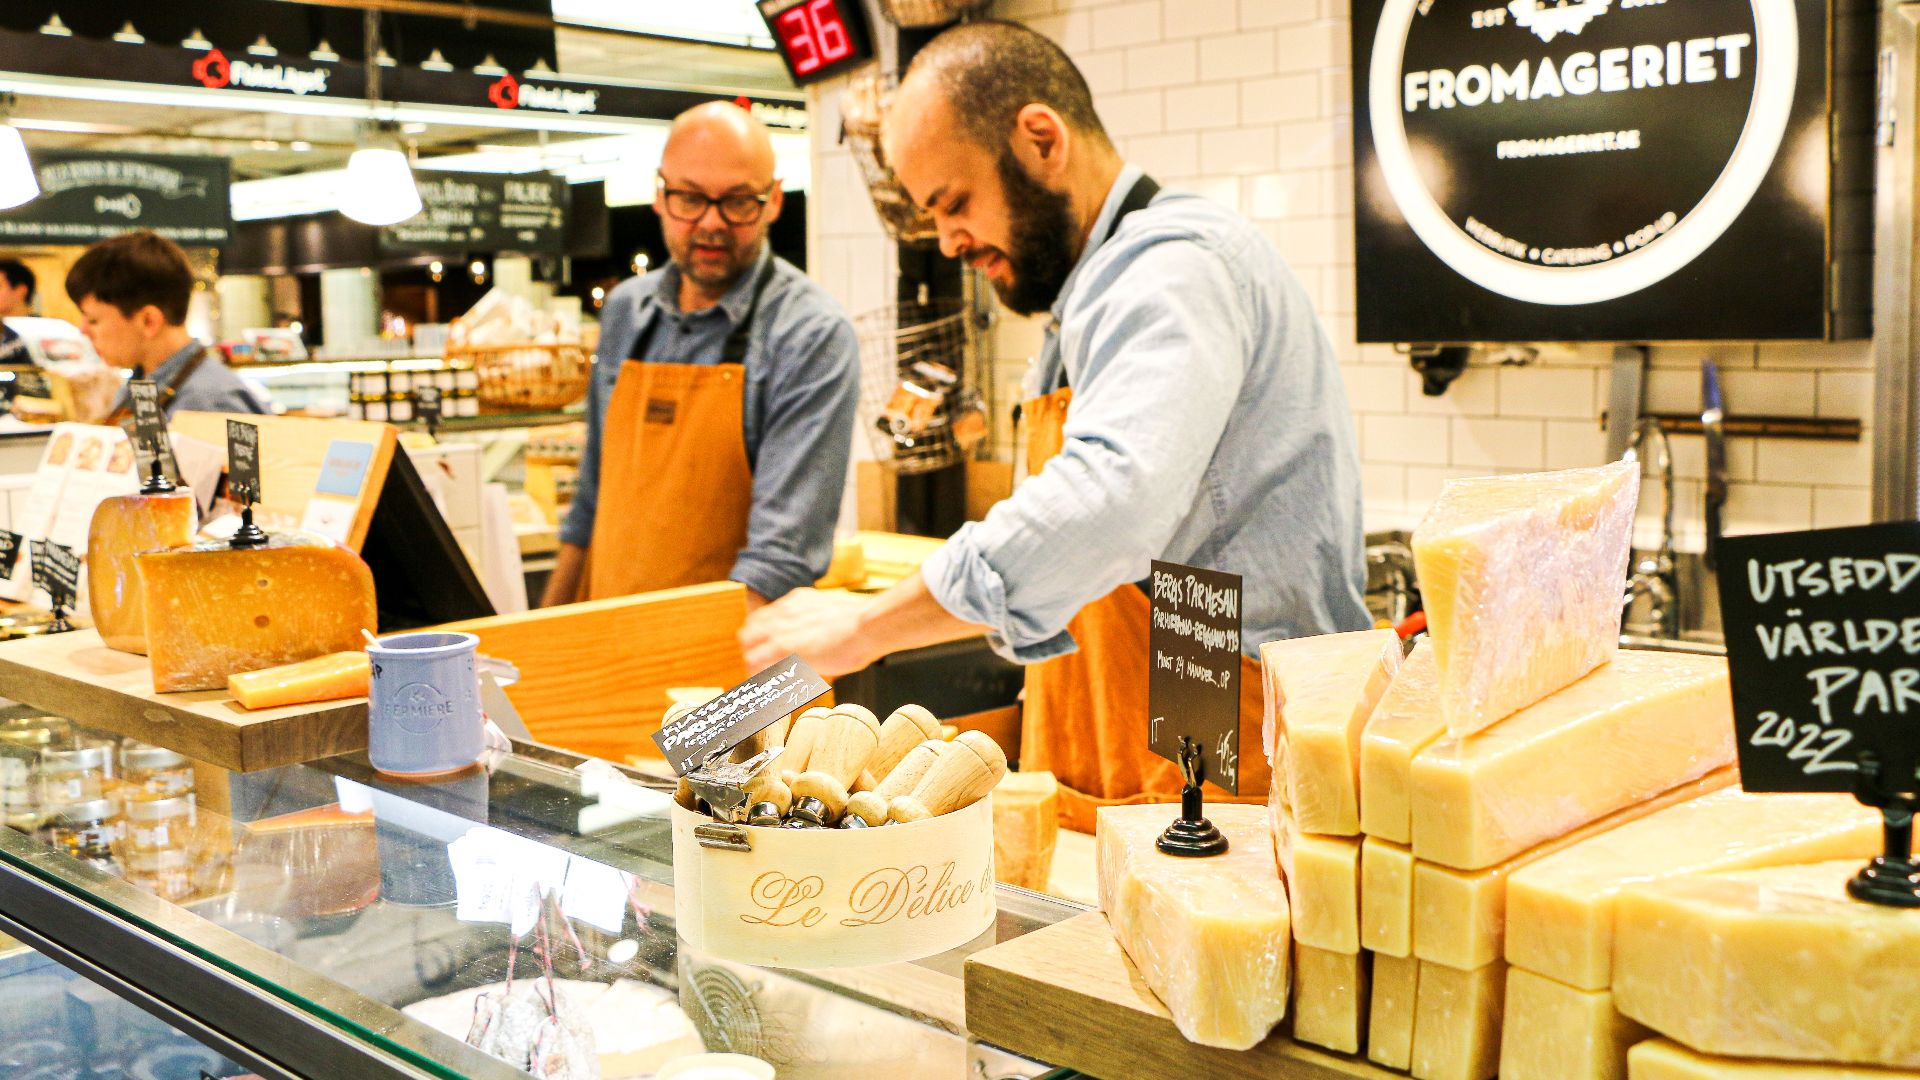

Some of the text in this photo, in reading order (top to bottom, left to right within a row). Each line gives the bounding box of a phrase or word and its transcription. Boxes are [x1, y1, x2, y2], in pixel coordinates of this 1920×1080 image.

[783, 0, 850, 72] 36
[1472, 8, 1507, 29] EST
[1404, 33, 1751, 113] FROMAGERIET
[1496, 129, 1641, 159] FROMAGERIET.SE
[1541, 242, 1613, 266] CATERING
[1185, 574, 1238, 619] PARMESAN
[1747, 553, 1920, 603] UTSEDD
[1755, 608, 1920, 661] VÄRLDE
[662, 663, 798, 751] PARMESANKNIV
[1806, 666, 1920, 725] PAR
[1151, 717, 1164, 745] IT
[1750, 711, 1859, 775] 2022
[740, 871, 828, 928] Le
[840, 861, 974, 928] Délice
